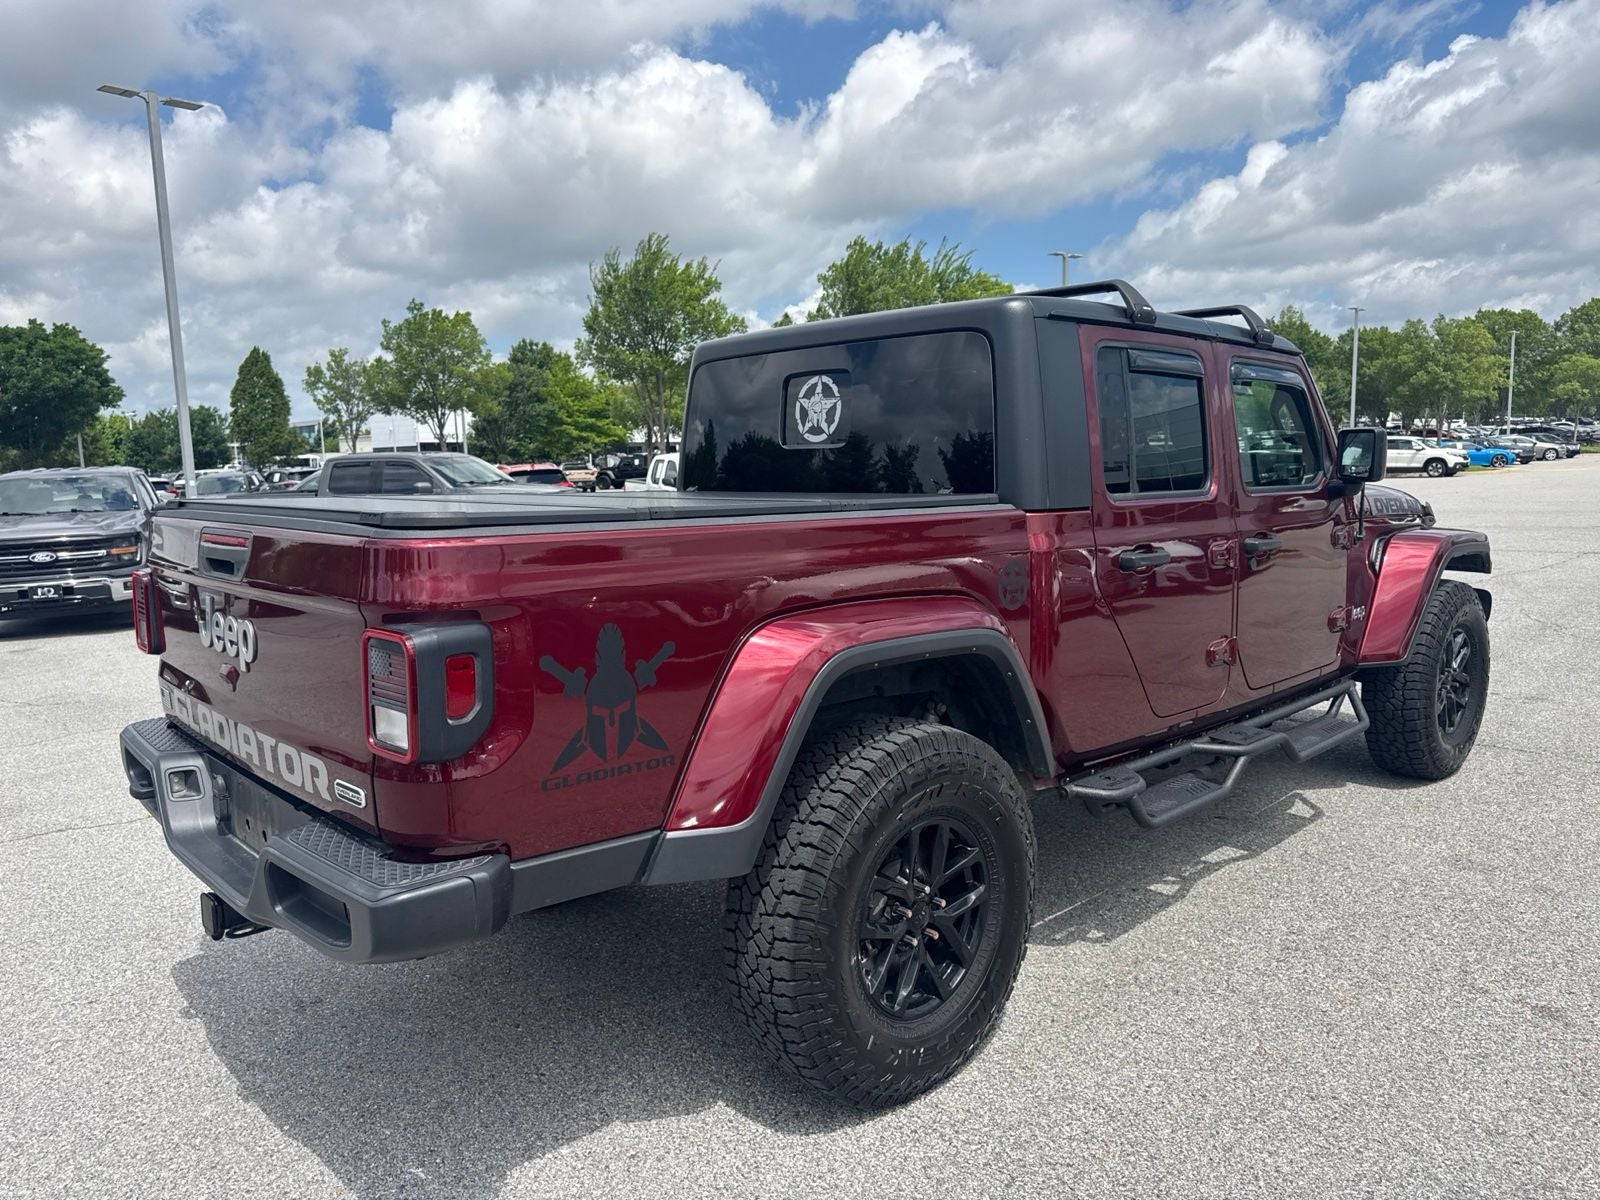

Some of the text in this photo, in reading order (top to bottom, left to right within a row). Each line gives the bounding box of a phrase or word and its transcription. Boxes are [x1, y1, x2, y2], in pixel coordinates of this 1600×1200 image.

[199, 594, 257, 673] Jeep
[174, 690, 332, 802] GLADIATOR
[541, 755, 676, 792] GLADIATOR
